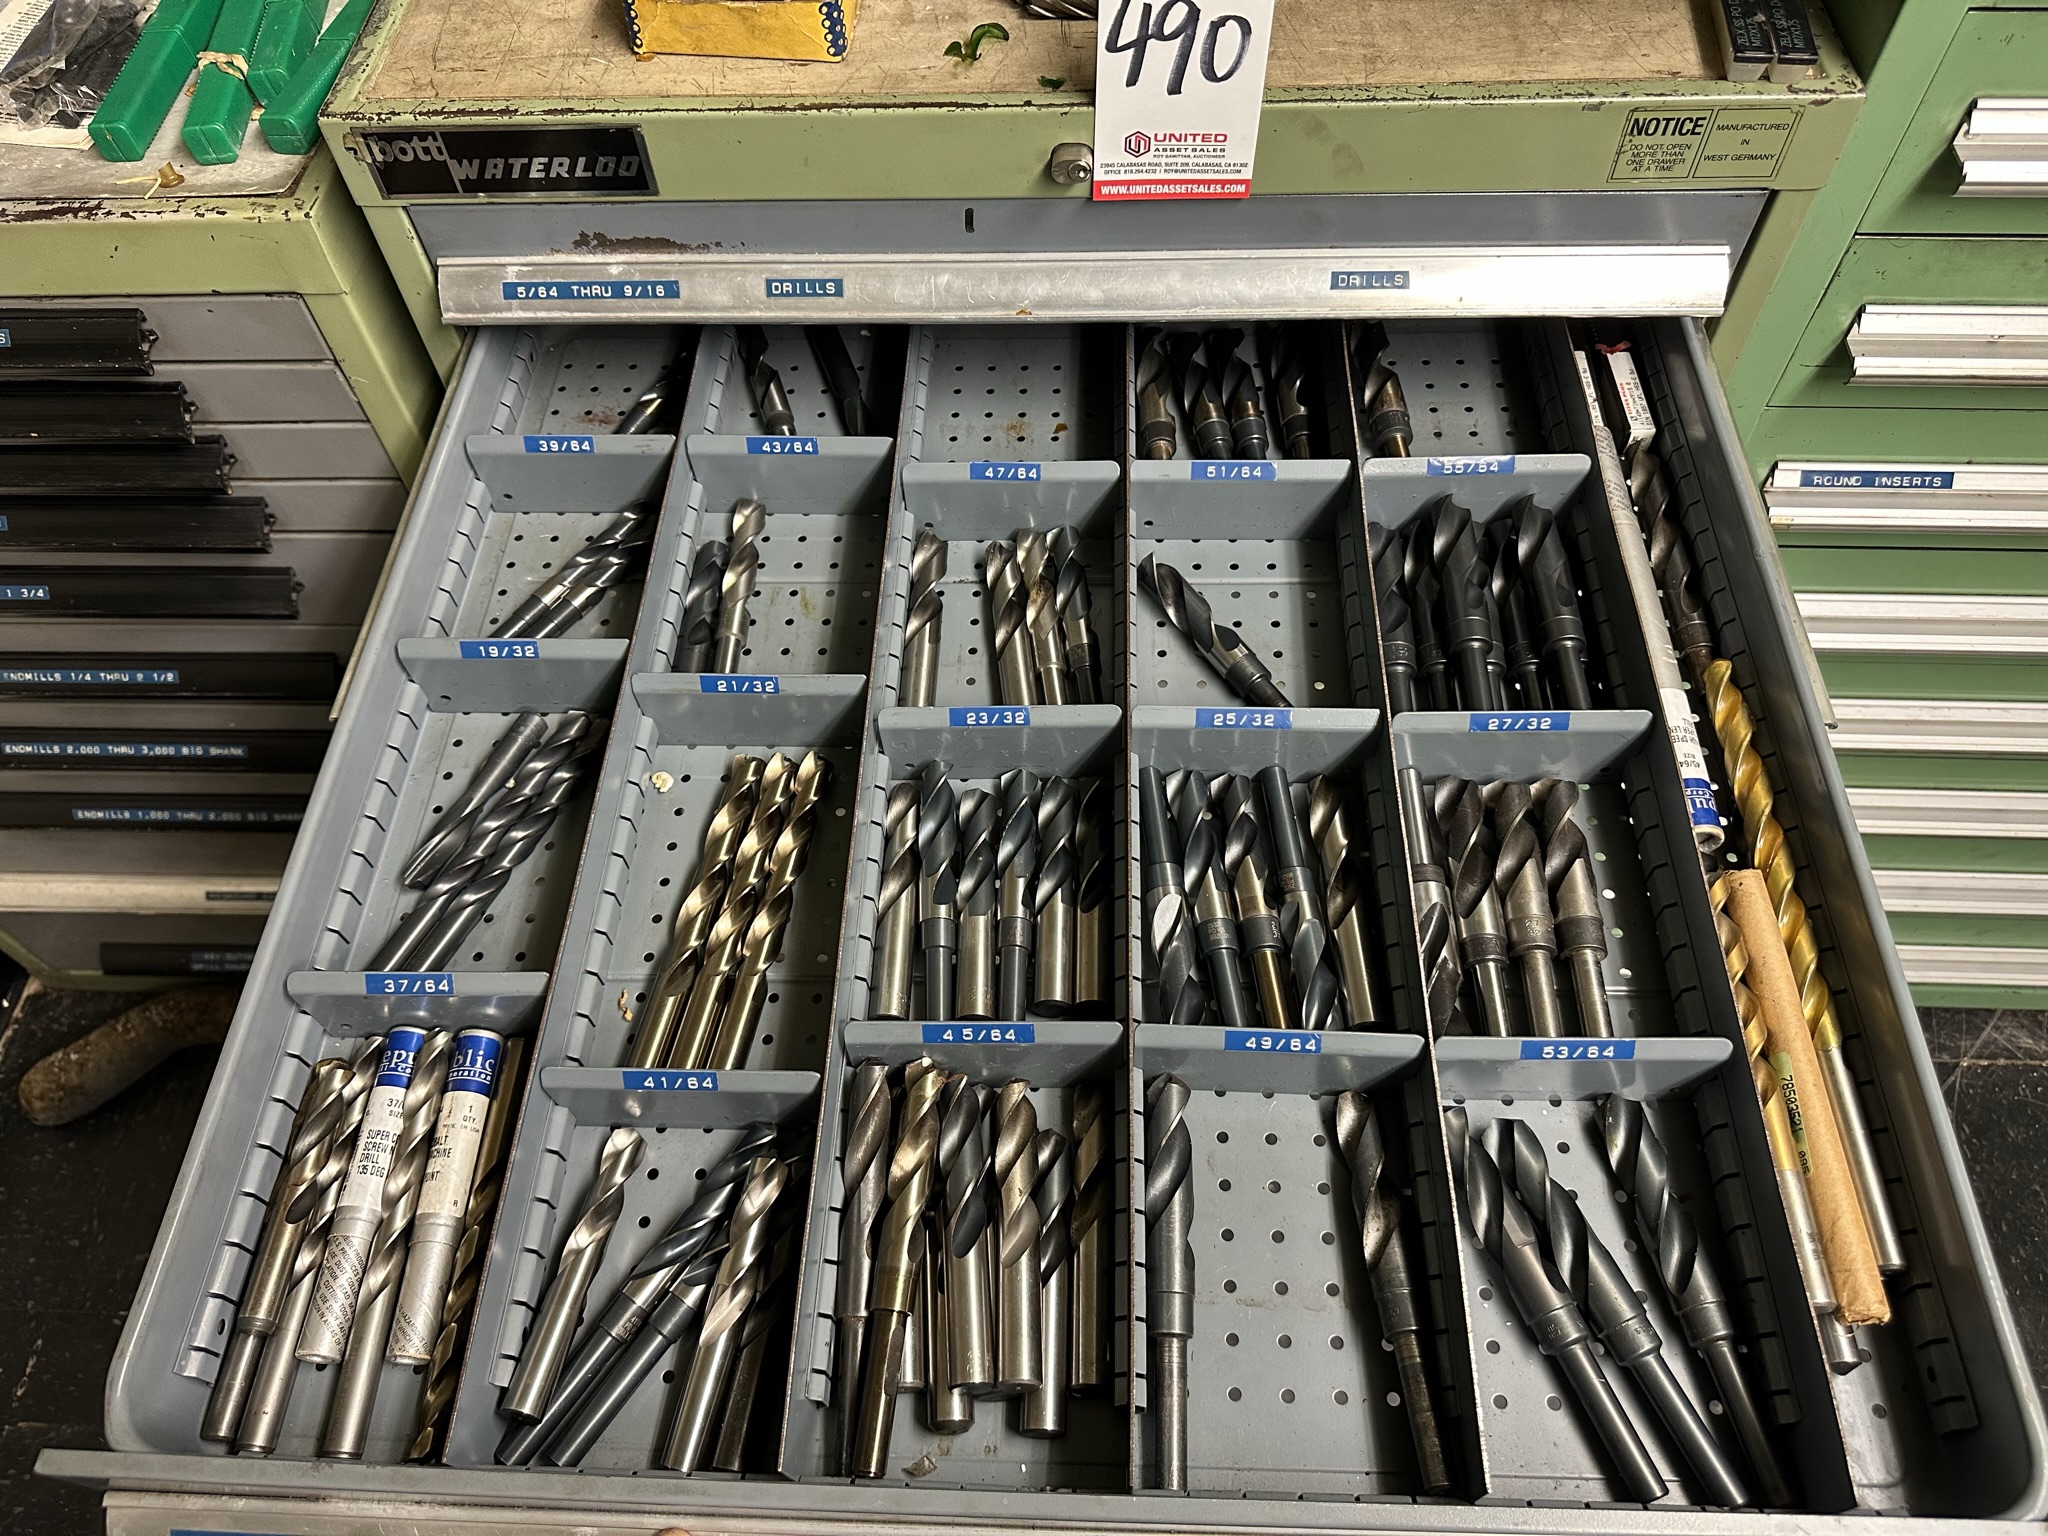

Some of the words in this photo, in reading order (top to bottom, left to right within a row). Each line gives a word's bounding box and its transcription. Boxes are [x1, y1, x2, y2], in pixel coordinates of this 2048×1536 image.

[1104, 0, 1252, 96] 490
[1629, 117, 1707, 137] NOTICE
[1715, 123, 1790, 131] MANUFACTURED
[1153, 133, 1228, 143] UNITED
[1703, 154, 1729, 162] WEST
[1730, 153, 1777, 161] GERMANY
[450, 155, 641, 180] WATERLOO
[1631, 165, 1643, 173] AT
[1100, 184, 1246, 195] WWW.UNITEDASSETSALES.COM
[1338, 275, 1404, 287] DRILLS
[516, 286, 559, 298] 5/64
[570, 285, 612, 298] THRU
[623, 285, 666, 297] 9/16
[771, 281, 837, 295] DRILLS
[538, 440, 592, 452] 39/64
[761, 441, 814, 453] 43/64
[984, 467, 1038, 479] 47/64
[1206, 466, 1262, 478] 51/64
[1813, 476, 1862, 487] ROUND
[1874, 476, 1943, 487] INSERTS
[21, 588, 45, 598] 3/4
[478, 645, 536, 658] 19/32
[70, 672, 92, 681] 1/4
[100, 673, 129, 682] THRU
[716, 680, 775, 692] 21/32
[966, 711, 1026, 724] 23/32
[1213, 713, 1275, 726] 25/32
[1487, 718, 1552, 731] 27/32
[5, 745, 60, 754] ENDMILLS
[383, 979, 450, 993] 37/64
[942, 1028, 1016, 1041] 45/64
[1244, 1037, 1317, 1051] 49/64
[1541, 1046, 1615, 1059] 53/64
[643, 1076, 714, 1089] 41/64
[468, 1105, 474, 1114] 1
[366, 1128, 391, 1143] SUPER
[362, 1141, 389, 1155] SCREW
[359, 1153, 380, 1165] DRILL
[356, 1163, 369, 1176] 135
[369, 1166, 386, 1178] DEG
